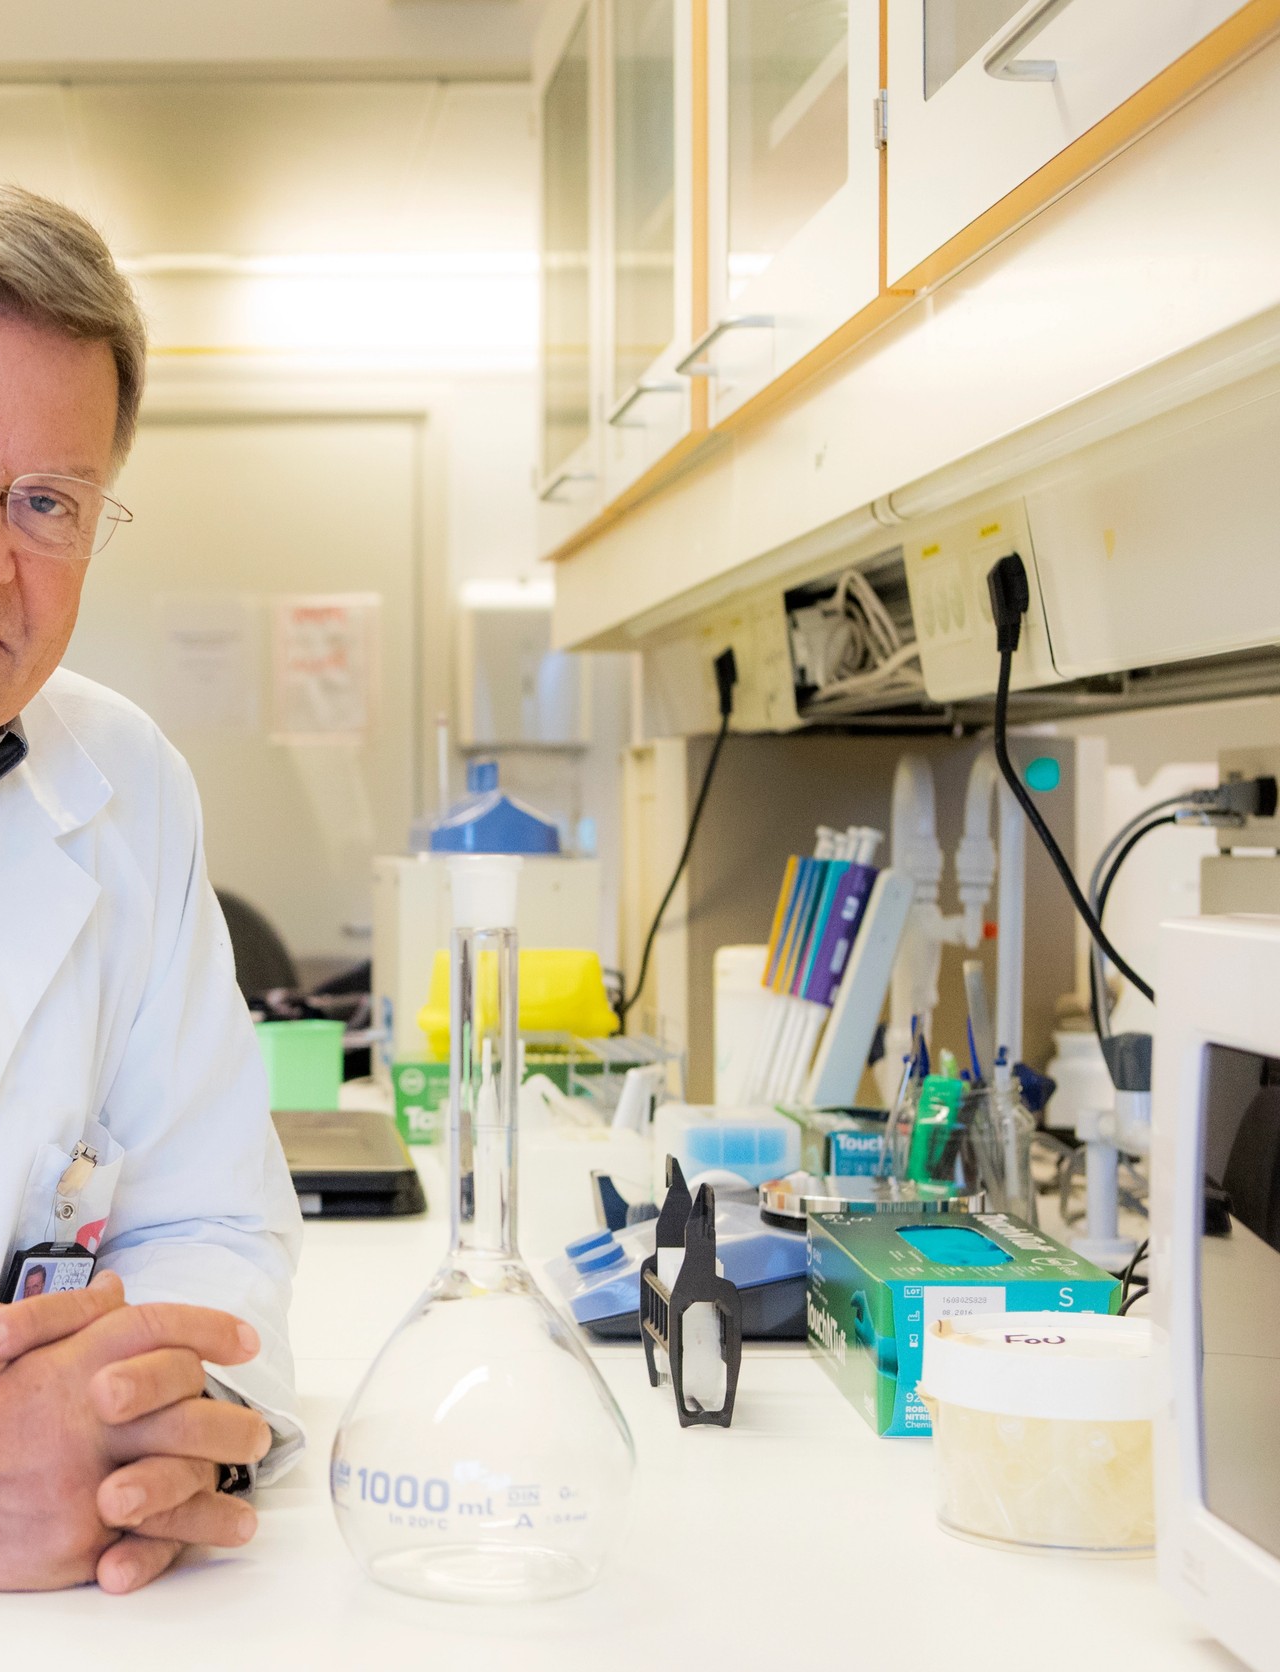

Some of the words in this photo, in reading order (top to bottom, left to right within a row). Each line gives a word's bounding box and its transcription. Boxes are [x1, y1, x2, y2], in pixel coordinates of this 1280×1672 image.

[1059, 1287, 1074, 1307] S
[358, 1468, 450, 1513] 1000
[458, 1497, 493, 1516] ml
[507, 1490, 539, 1501] DIN
[515, 1513, 534, 1529] A
